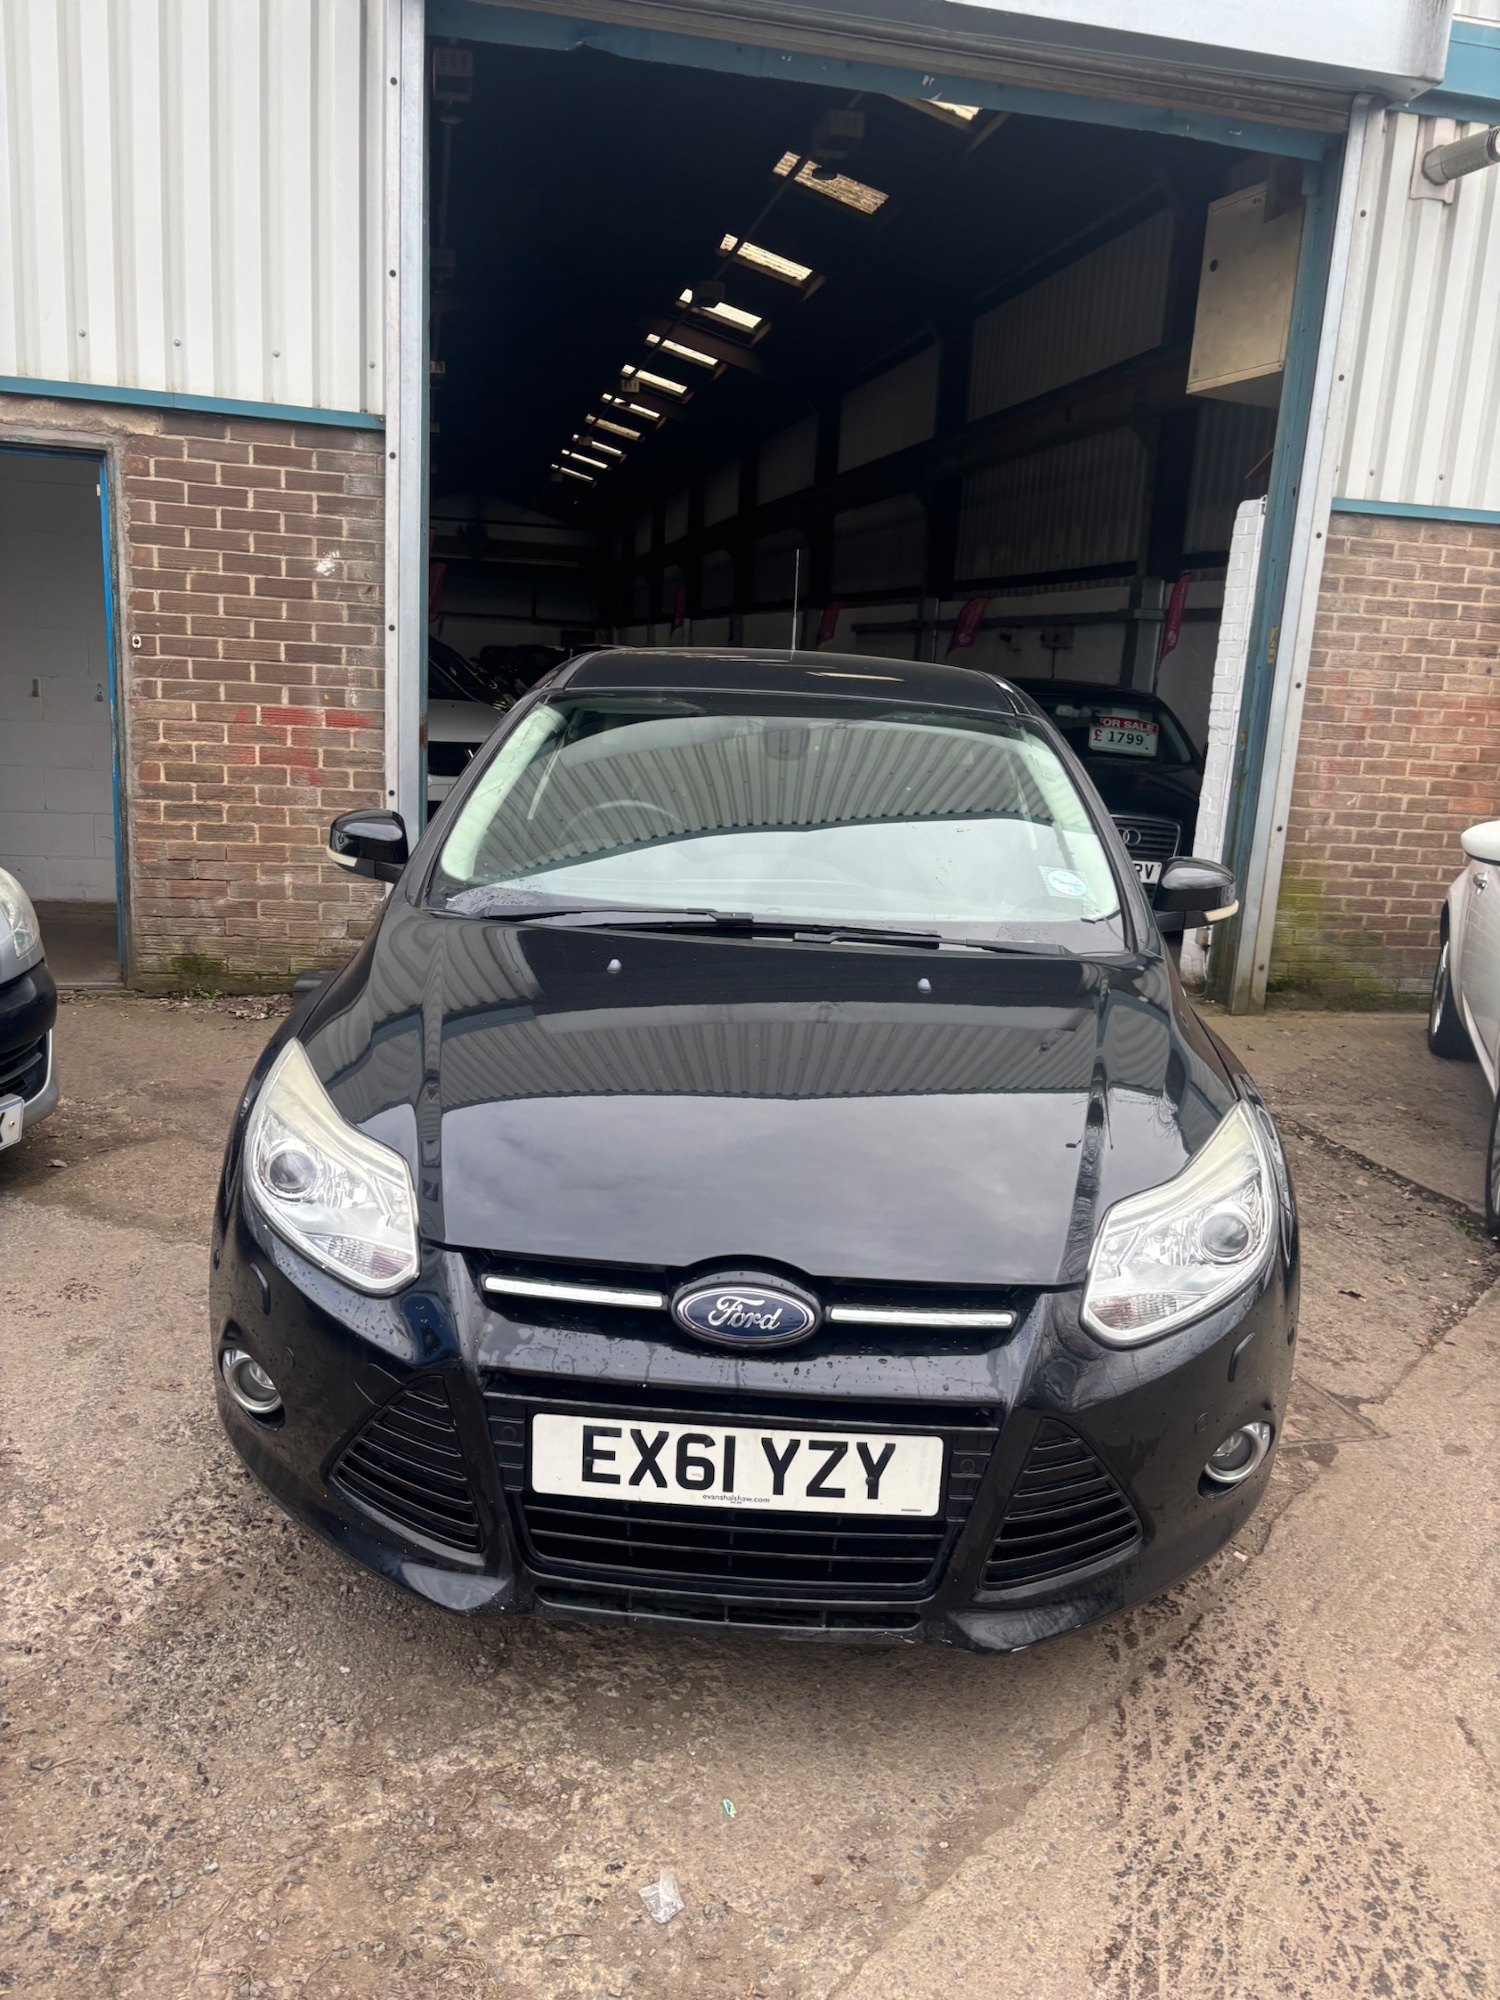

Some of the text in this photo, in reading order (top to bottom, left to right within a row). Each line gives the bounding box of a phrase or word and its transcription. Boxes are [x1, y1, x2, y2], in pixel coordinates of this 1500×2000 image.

[1123, 721, 1154, 732] SALE
[1093, 729, 1144, 746] £ 1799
[707, 1295, 780, 1331] Ford
[582, 1425, 896, 1500] EX61 YZY
[702, 1494, 771, 1503] evanshalshaw.com
